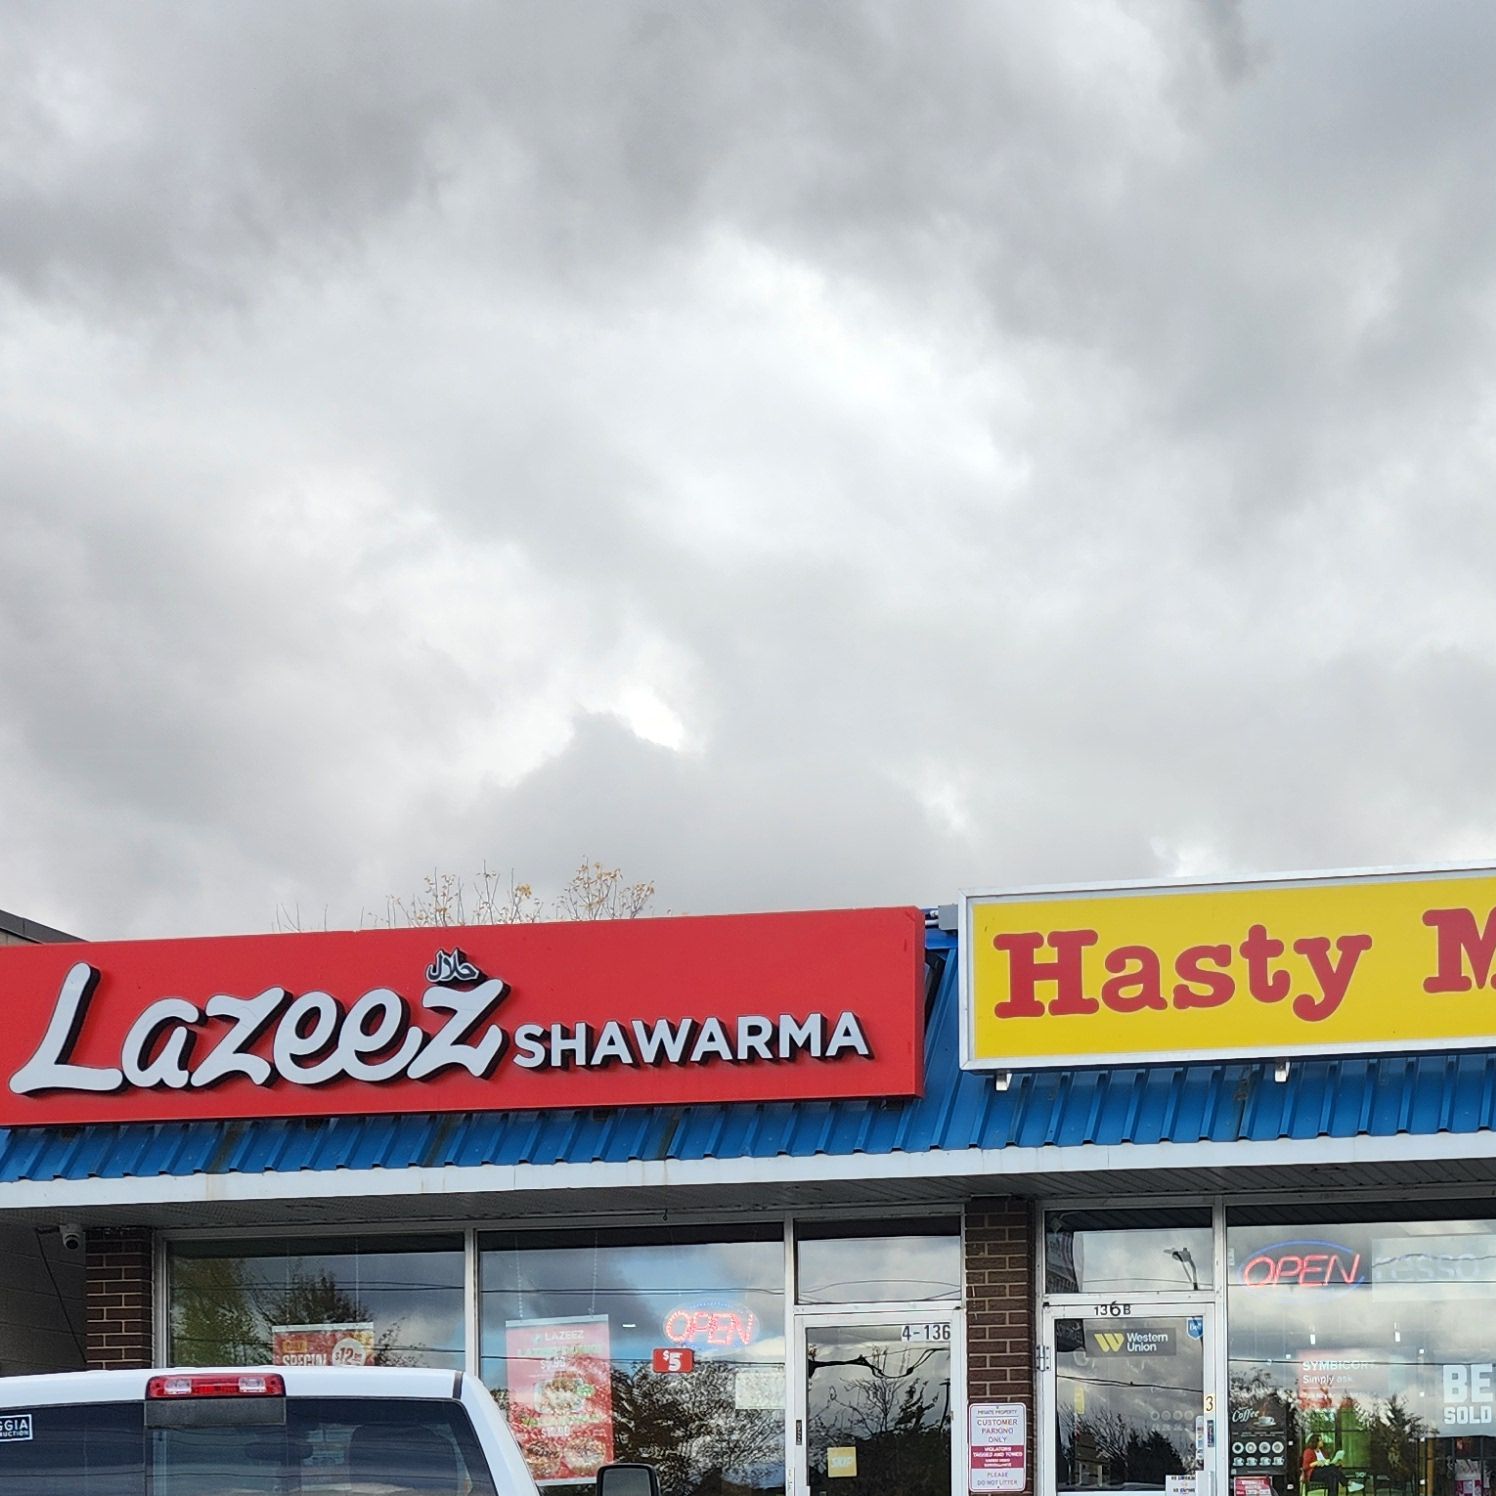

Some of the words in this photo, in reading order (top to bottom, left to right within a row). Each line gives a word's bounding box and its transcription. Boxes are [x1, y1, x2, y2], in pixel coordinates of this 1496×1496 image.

[993, 924, 1373, 1022] Hasty
[514, 1011, 871, 1069] SHAWARMA
[1243, 1254, 1361, 1287] OPEN
[545, 1330, 585, 1340] LAZEEZ
[666, 1311, 754, 1345] OPEN
[902, 1325, 951, 1341] 4-136
[1127, 1332, 1169, 1342] Western
[1127, 1342, 1157, 1352] Union
[663, 1350, 682, 1371] $5
[1303, 1374, 1334, 1385] Simply
[1232, 1406, 1260, 1422] Coffee
[1444, 1406, 1492, 1425] SOLD
